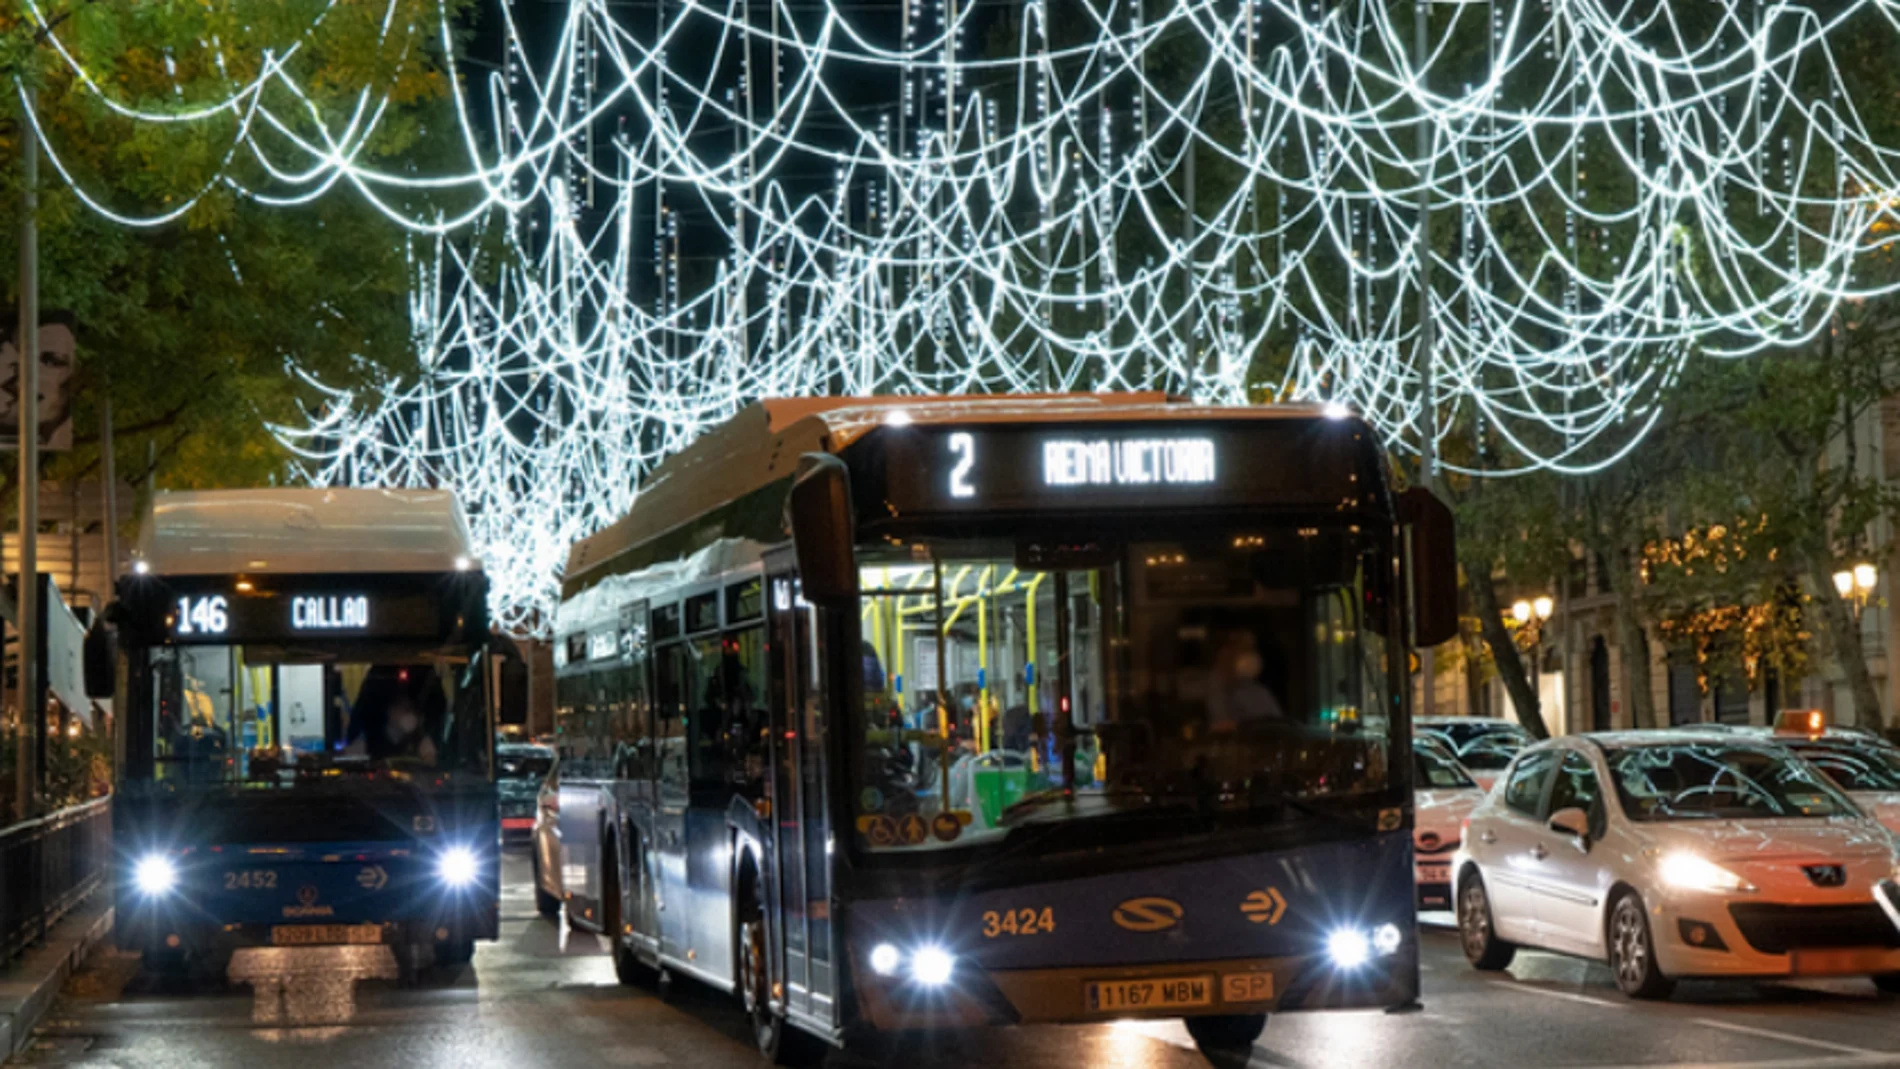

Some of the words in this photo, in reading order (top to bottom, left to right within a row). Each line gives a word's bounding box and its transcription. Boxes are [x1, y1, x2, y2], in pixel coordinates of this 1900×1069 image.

[948, 432, 975, 497] 2
[1044, 440, 1111, 484] REINA
[1113, 438, 1216, 483] VICTORIA
[176, 595, 228, 633] 146
[292, 597, 368, 628] CALLAO
[224, 871, 278, 889] 2452
[983, 906, 1056, 938] 3424
[1104, 983, 1155, 1007] 1167
[1229, 977, 1266, 999] SP
